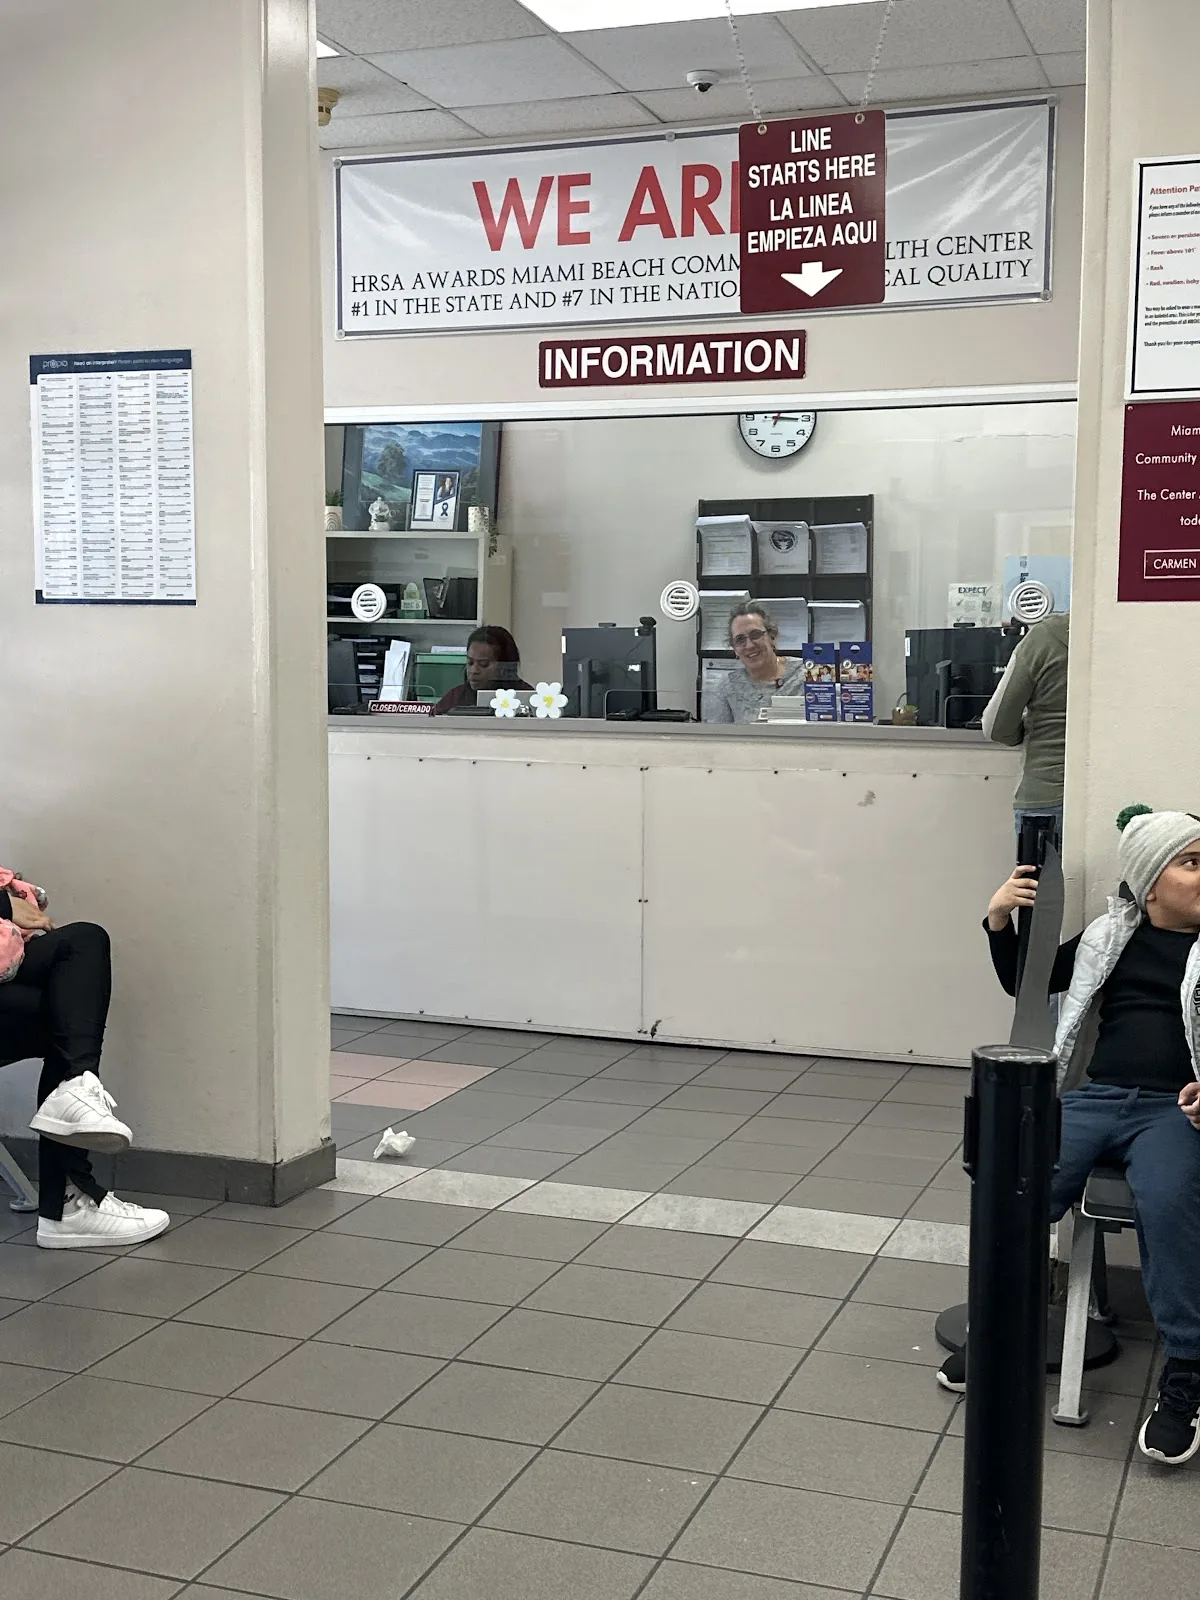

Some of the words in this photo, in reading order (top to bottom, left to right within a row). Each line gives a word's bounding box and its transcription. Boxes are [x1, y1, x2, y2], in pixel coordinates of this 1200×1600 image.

[791, 127, 832, 153] LINE
[748, 159, 820, 188] STARTS
[826, 153, 876, 180] HERE
[1150, 186, 1188, 195] Attention
[472, 173, 591, 251] WE
[770, 198, 794, 221] LA
[799, 192, 853, 219] LINEA
[747, 225, 827, 253] EMPIEZA
[832, 220, 877, 246] AQUI
[351, 274, 405, 293] HRSA
[412, 268, 505, 290] AWARDS
[512, 263, 585, 285] MIAMI
[592, 258, 665, 280] BEACH
[936, 231, 1033, 256] CENTER
[351, 301, 369, 316] #1
[375, 299, 397, 316] IN
[403, 297, 440, 315] THE
[446, 294, 503, 313] STATE
[509, 291, 556, 310] AND
[562, 289, 583, 306] #7
[590, 288, 614, 305] IN
[620, 285, 660, 304] THE
[667, 280, 740, 301] NATIO
[928, 259, 1033, 286] QUALITY
[544, 338, 800, 380] INFORMATION
[745, 413, 755, 421] 9
[748, 428, 758, 436] 8
[756, 439, 766, 447] 7
[786, 439, 796, 447] 5
[771, 445, 781, 453] 6
[1135, 452, 1197, 466] Community
[1137, 488, 1157, 501] The
[1160, 488, 1196, 500] Center
[1153, 558, 1197, 570] CARMEN
[958, 586, 987, 594] EXPECT
[371, 703, 431, 713] CLOSED/CERRADO
